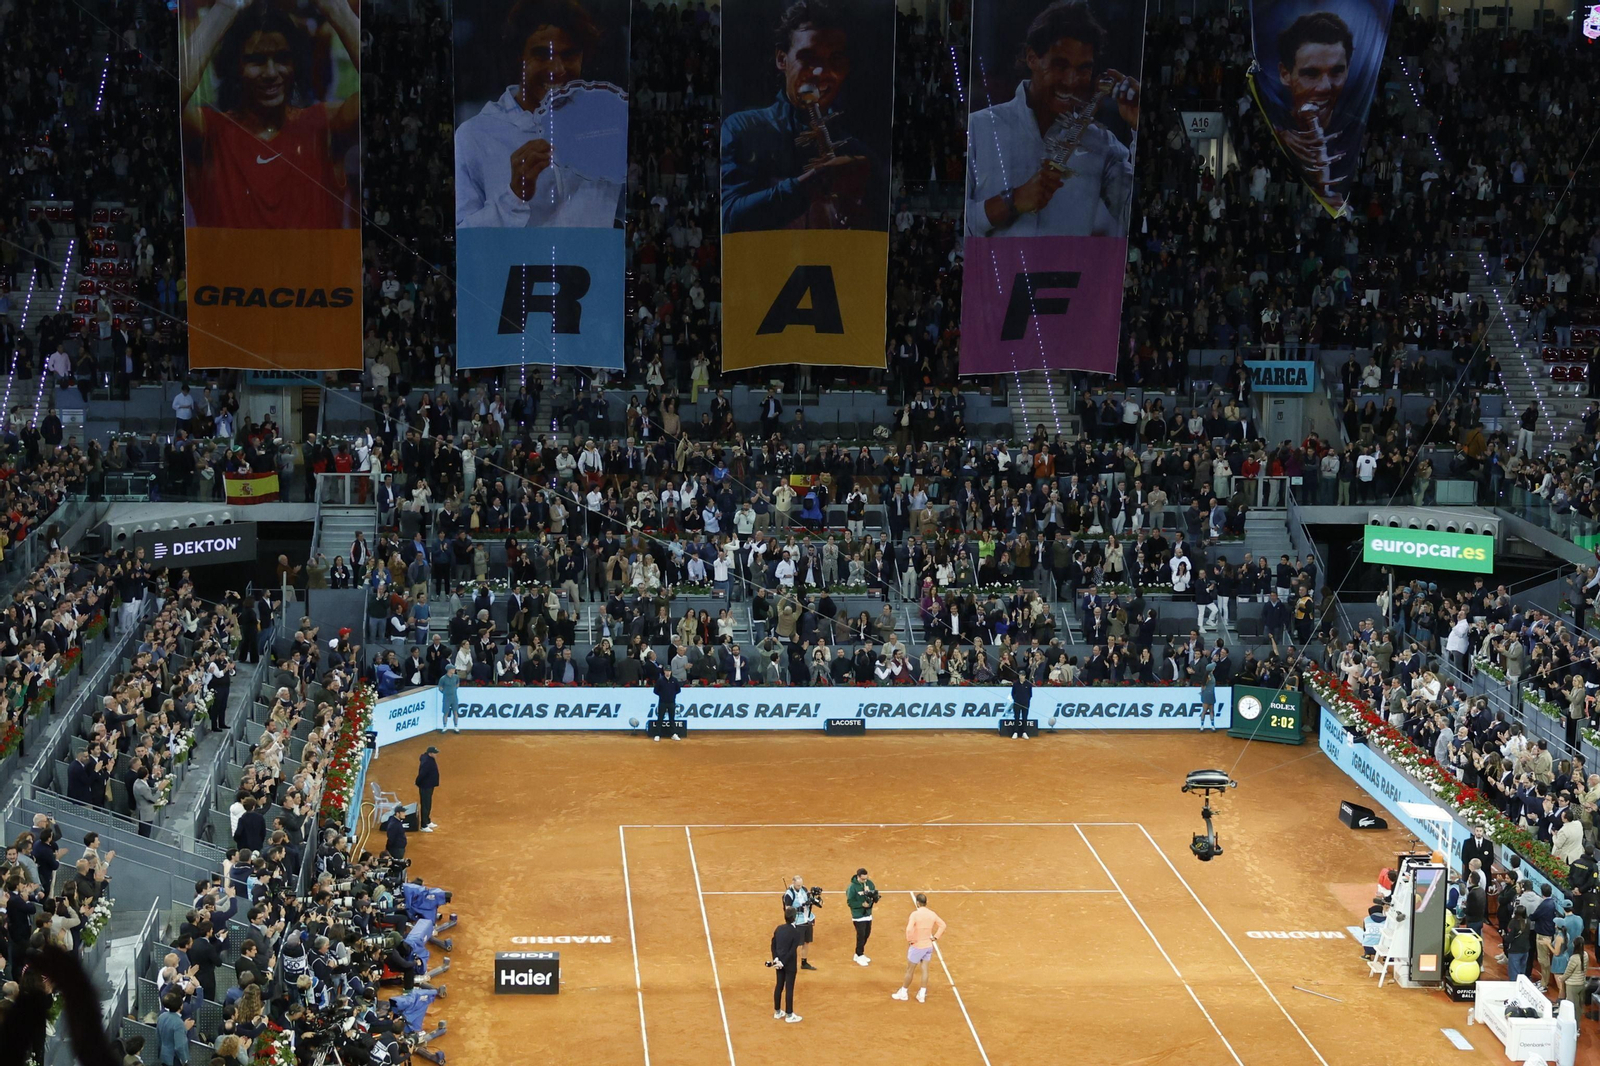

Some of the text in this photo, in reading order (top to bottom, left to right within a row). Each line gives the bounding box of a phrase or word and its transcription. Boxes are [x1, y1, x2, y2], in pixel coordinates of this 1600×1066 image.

[1191, 117, 1209, 128] A16
[193, 285, 355, 309] GRACIAS
[497, 265, 591, 335] R
[755, 265, 845, 335] A
[1000, 271, 1082, 341] F
[1250, 367, 1308, 386] MARCA
[1370, 538, 1486, 561] europcar.es
[388, 701, 426, 720] ¡GRACIAS
[554, 703, 621, 718] RAFA!
[647, 703, 821, 718] ¡RACIAS RAFA!
[855, 703, 1014, 718] ¡GRACIAS RAF
[1053, 703, 1154, 717] ¡GRACIAS
[1270, 702, 1296, 711] ROLEX
[395, 716, 420, 732] RAFA!
[1270, 715, 1295, 729] 2:02
[1352, 751, 1380, 789] ¡GRACIAS
[511, 935, 612, 944] MADRID
[1245, 930, 1346, 939] MADRID
[500, 968, 553, 986] Haier
